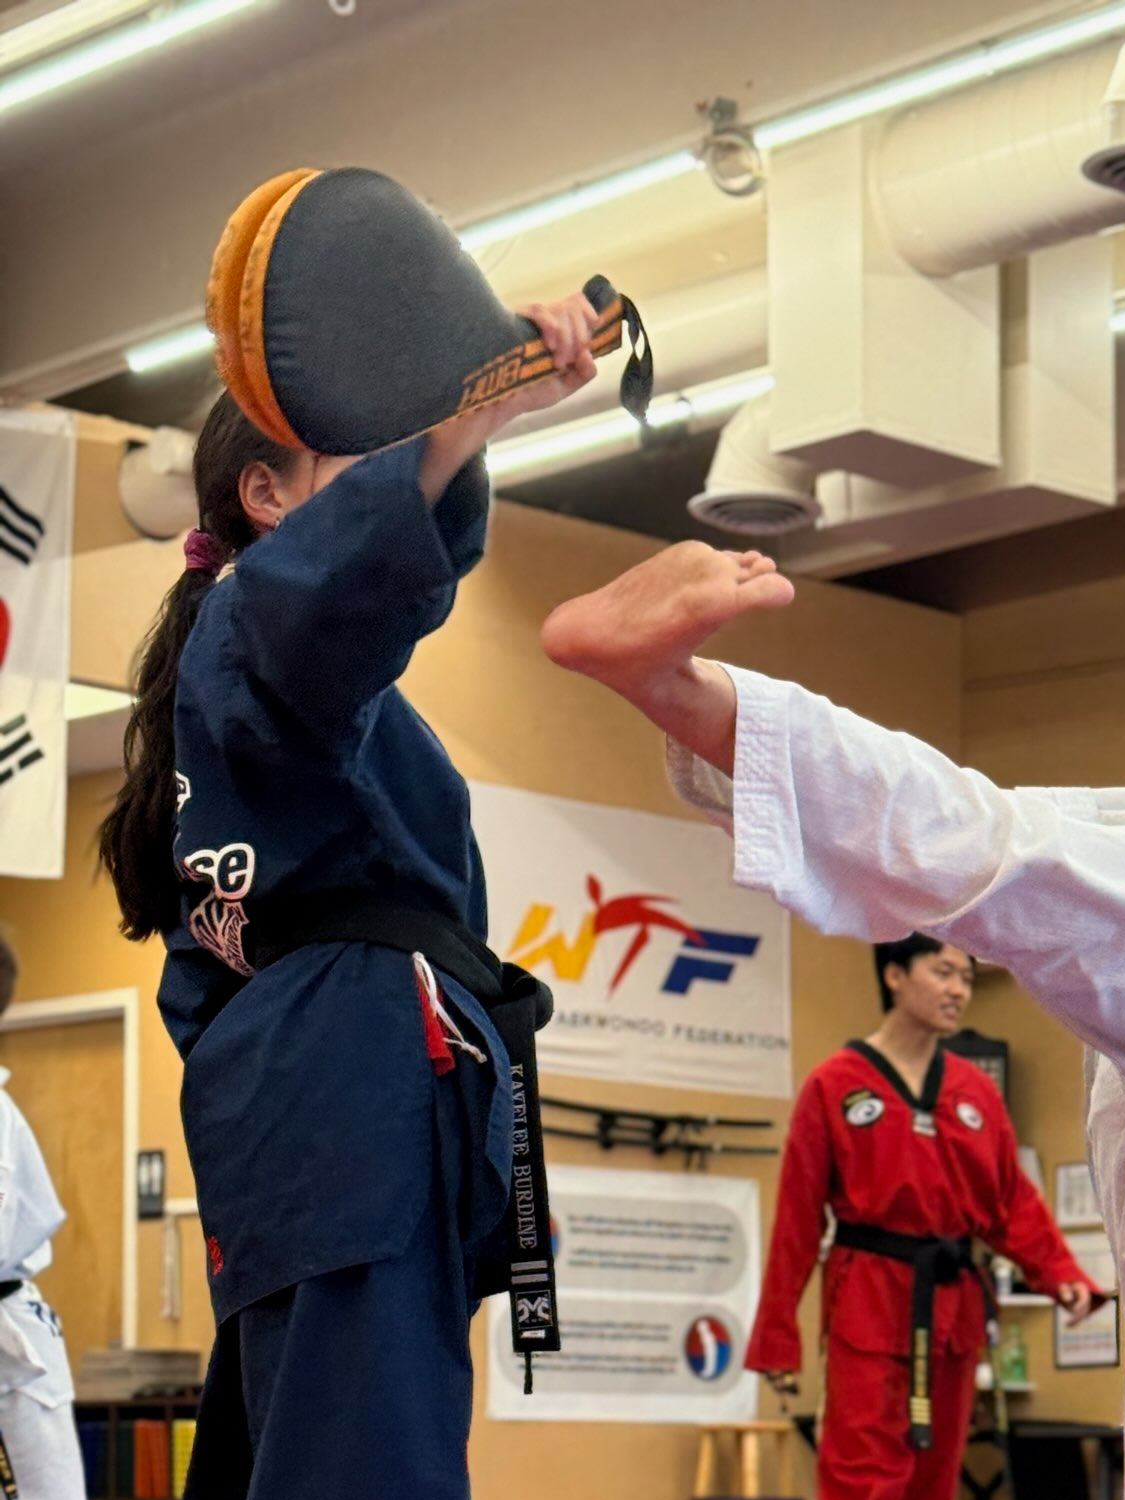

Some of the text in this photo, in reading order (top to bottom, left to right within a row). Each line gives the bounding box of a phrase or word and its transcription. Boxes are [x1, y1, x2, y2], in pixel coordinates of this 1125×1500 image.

[506, 873, 762, 1000] WTF
[553, 1010, 790, 1052] AEKWONDO FEDERATION
[511, 1164, 537, 1250] BURDINE
